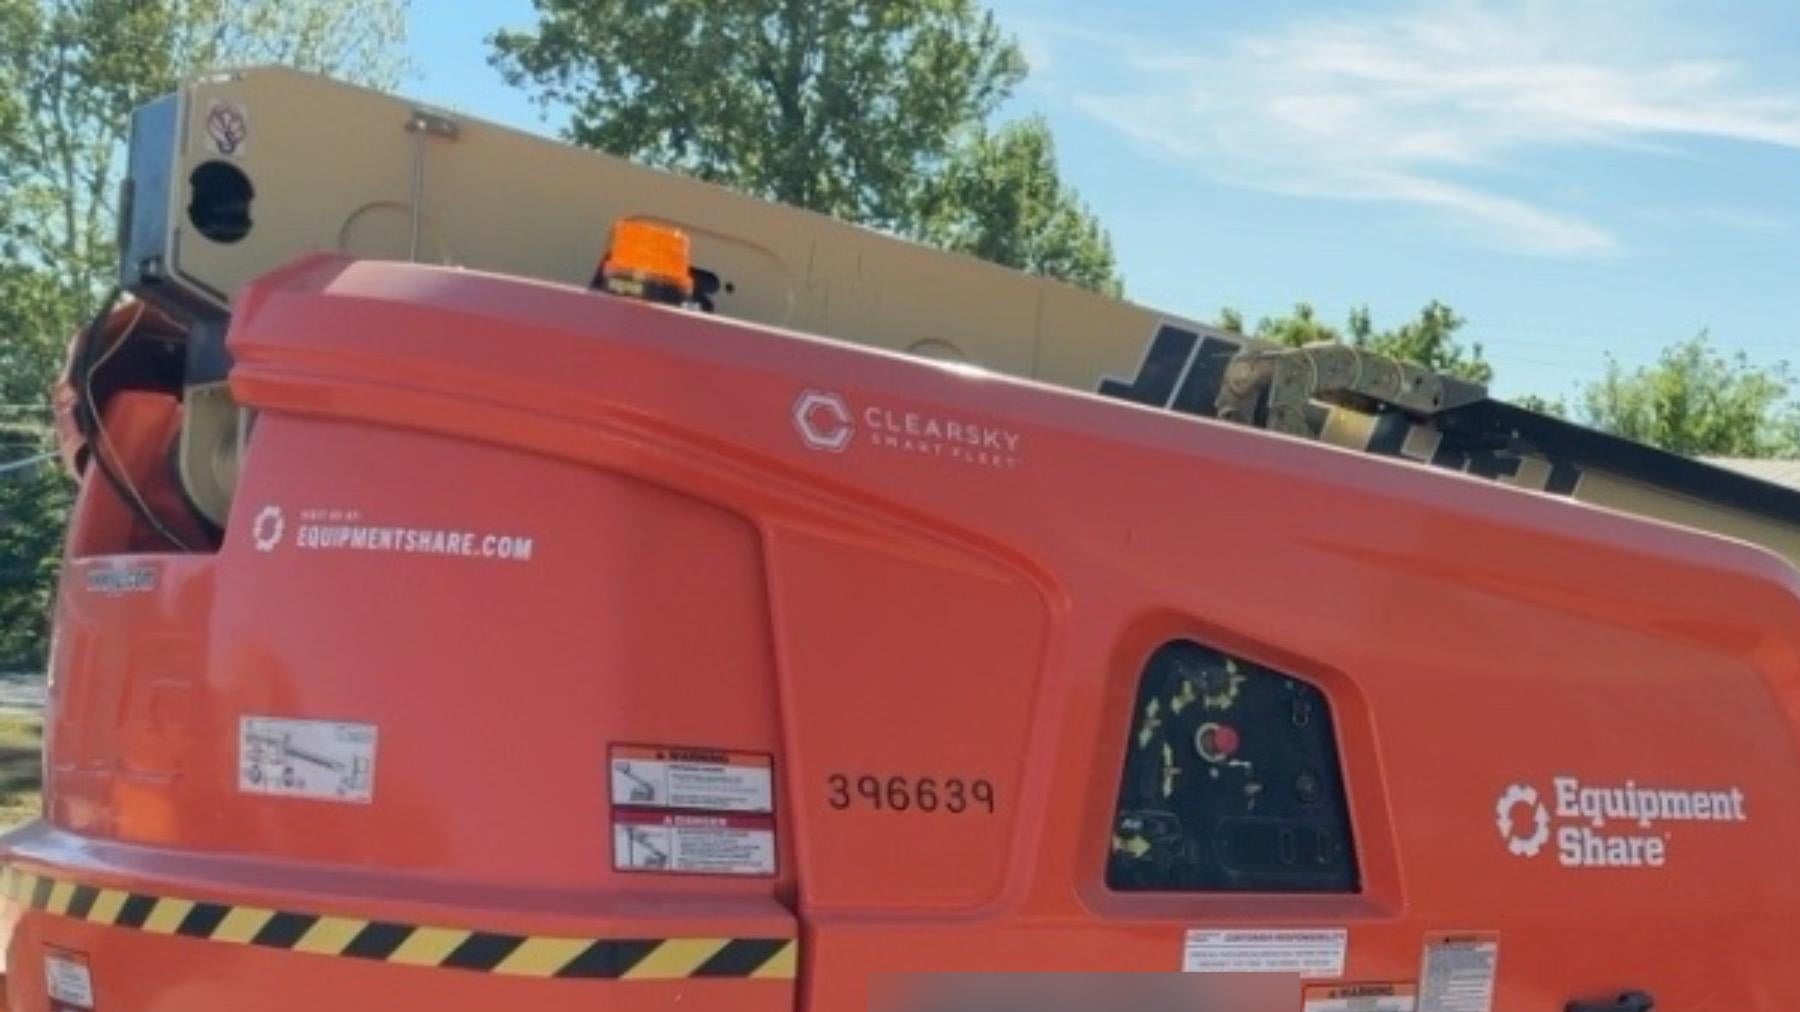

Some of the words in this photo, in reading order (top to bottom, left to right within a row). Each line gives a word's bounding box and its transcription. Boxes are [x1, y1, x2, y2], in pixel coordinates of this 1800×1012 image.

[864, 406, 1020, 451] CLEARSKY
[296, 525, 533, 560] EQUIPMENTSHARE.COM
[828, 774, 996, 813] 396639
[1553, 776, 1746, 827] Equipment
[1557, 826, 1666, 867] Share
